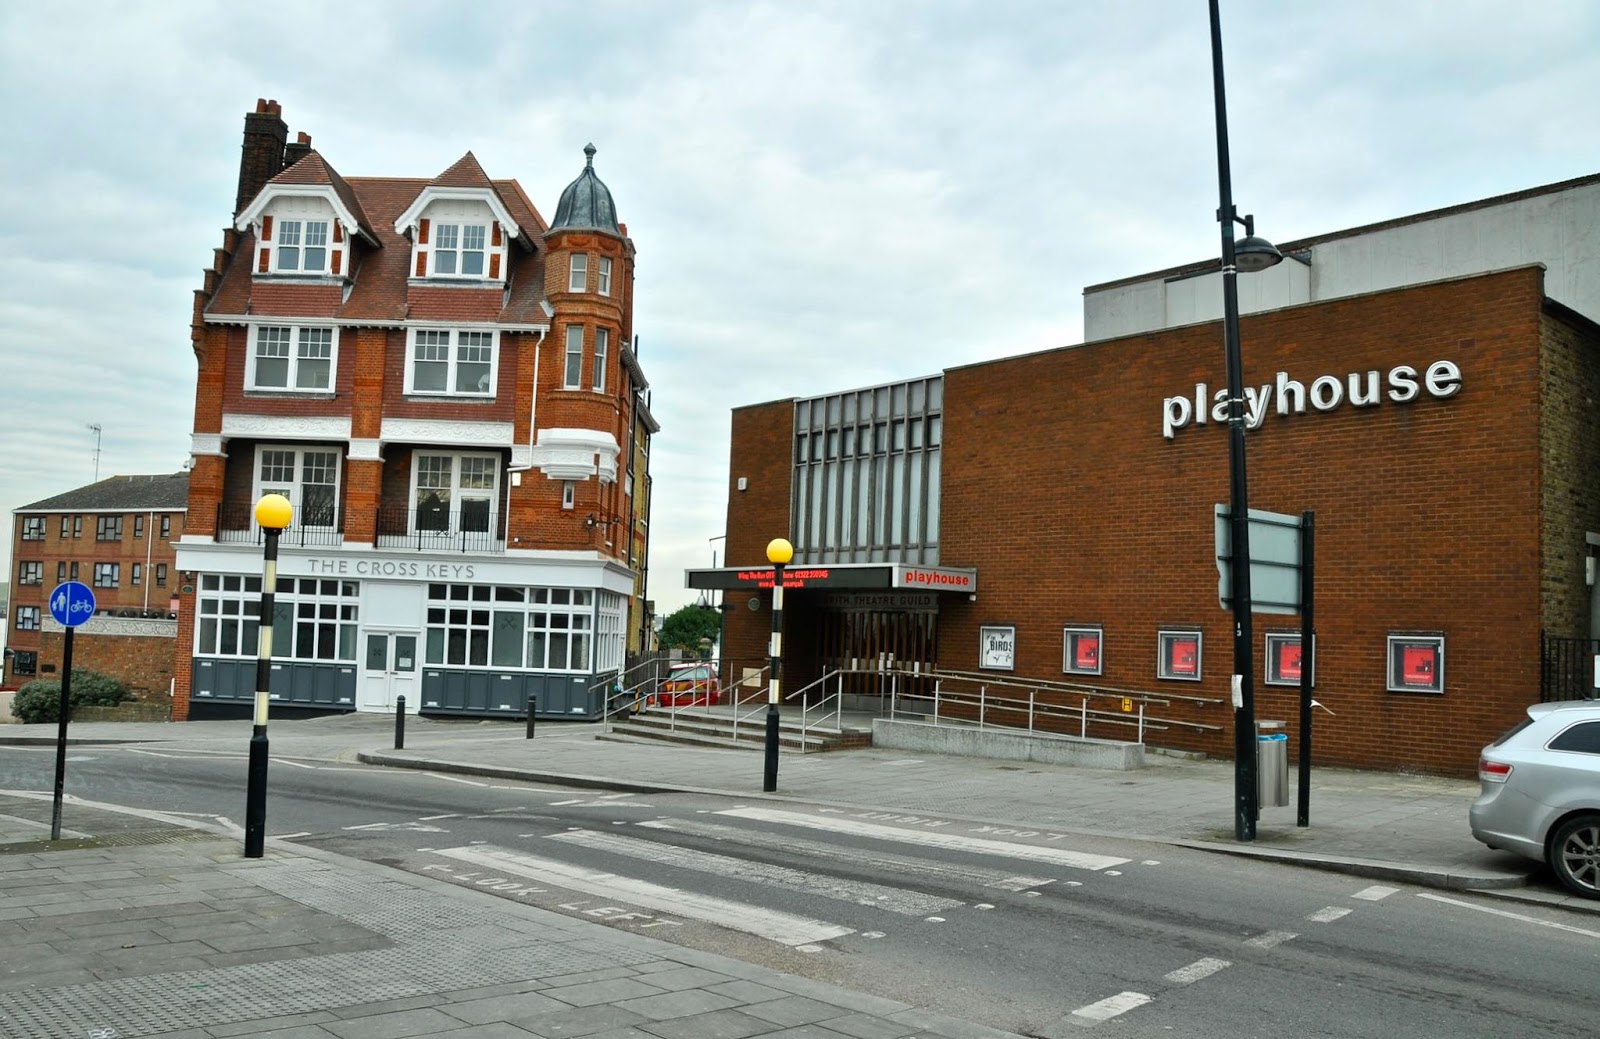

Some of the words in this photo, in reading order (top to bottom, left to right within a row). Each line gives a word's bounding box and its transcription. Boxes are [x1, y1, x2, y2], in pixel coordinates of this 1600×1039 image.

[1163, 360, 1462, 439] playhouse
[308, 559, 348, 574] THE
[356, 561, 418, 576] CROSS
[426, 564, 474, 579] KEYS
[905, 570, 969, 586] playhouse
[855, 596, 895, 605] THEATRE
[900, 596, 930, 605] GUILD
[990, 640, 1012, 652] BIRDS
[857, 812, 952, 828] RIGHT
[967, 825, 1069, 841] LOOK
[453, 872, 548, 896] LOOK
[558, 900, 684, 928] LEFT
